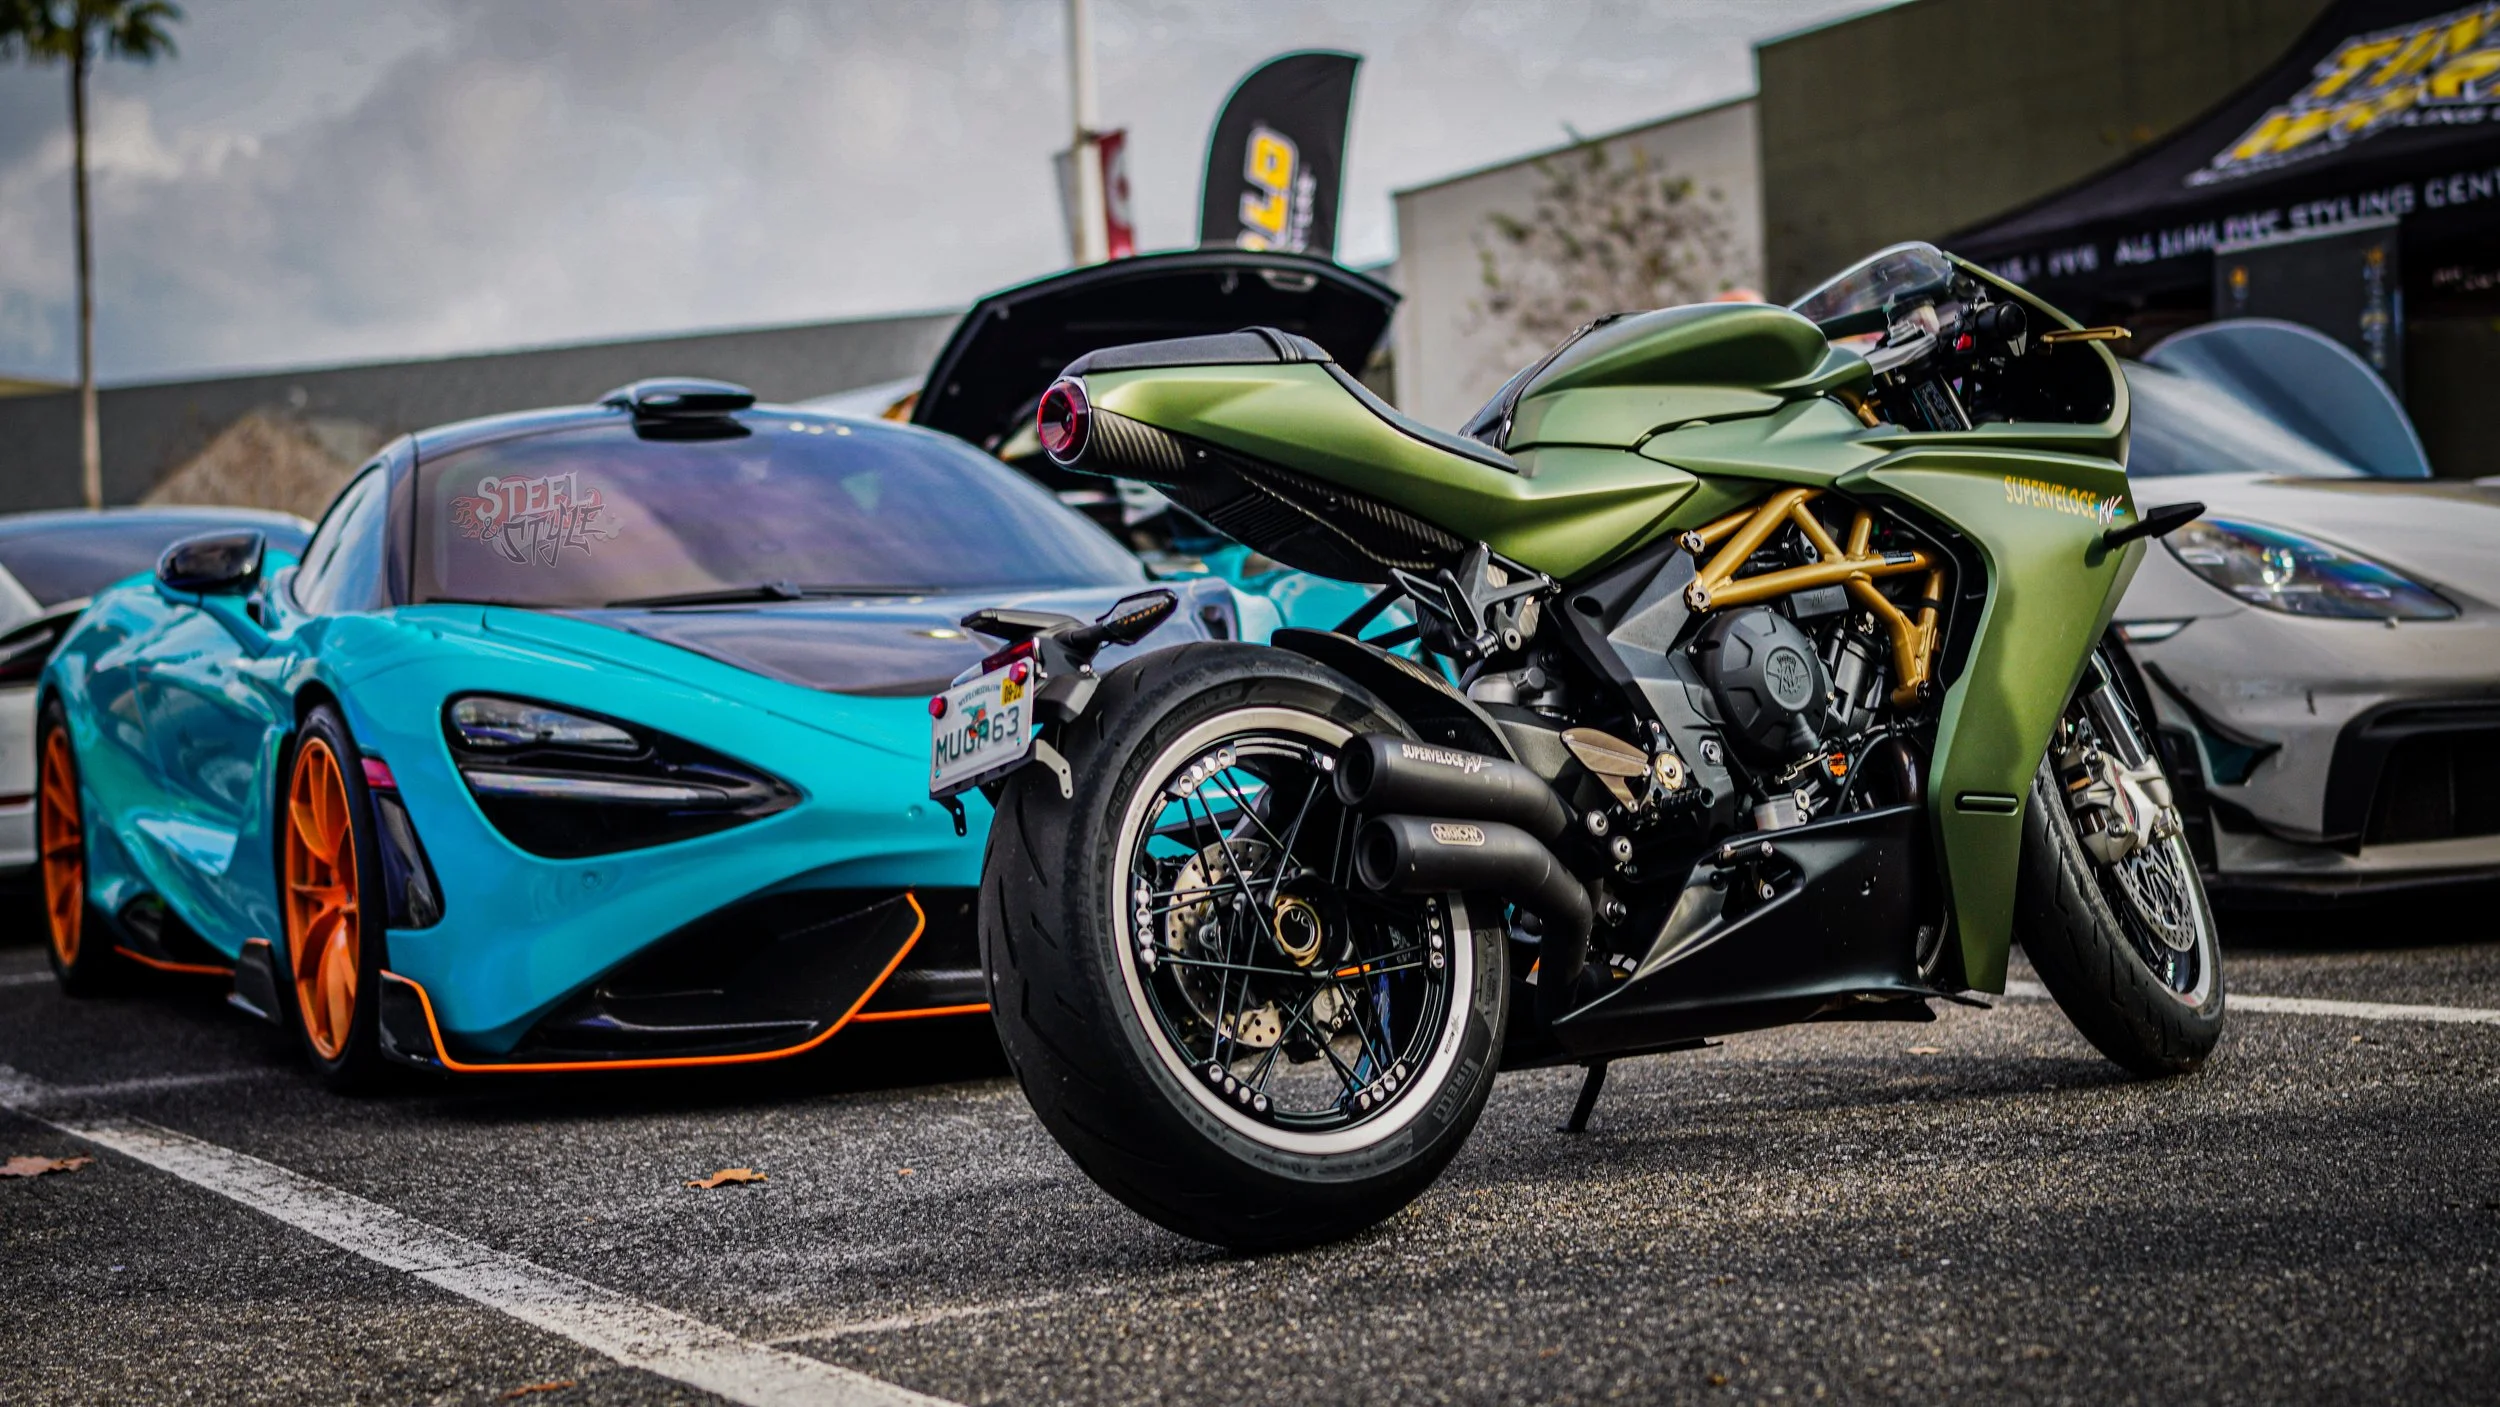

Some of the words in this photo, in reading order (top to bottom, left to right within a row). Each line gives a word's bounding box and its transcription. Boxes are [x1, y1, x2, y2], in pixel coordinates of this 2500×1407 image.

[2004, 474, 2096, 519] SUPERVELOCE
[1402, 743, 1464, 768] SUPERVELOCE
[1432, 1057, 1481, 1123] PIRELLI
